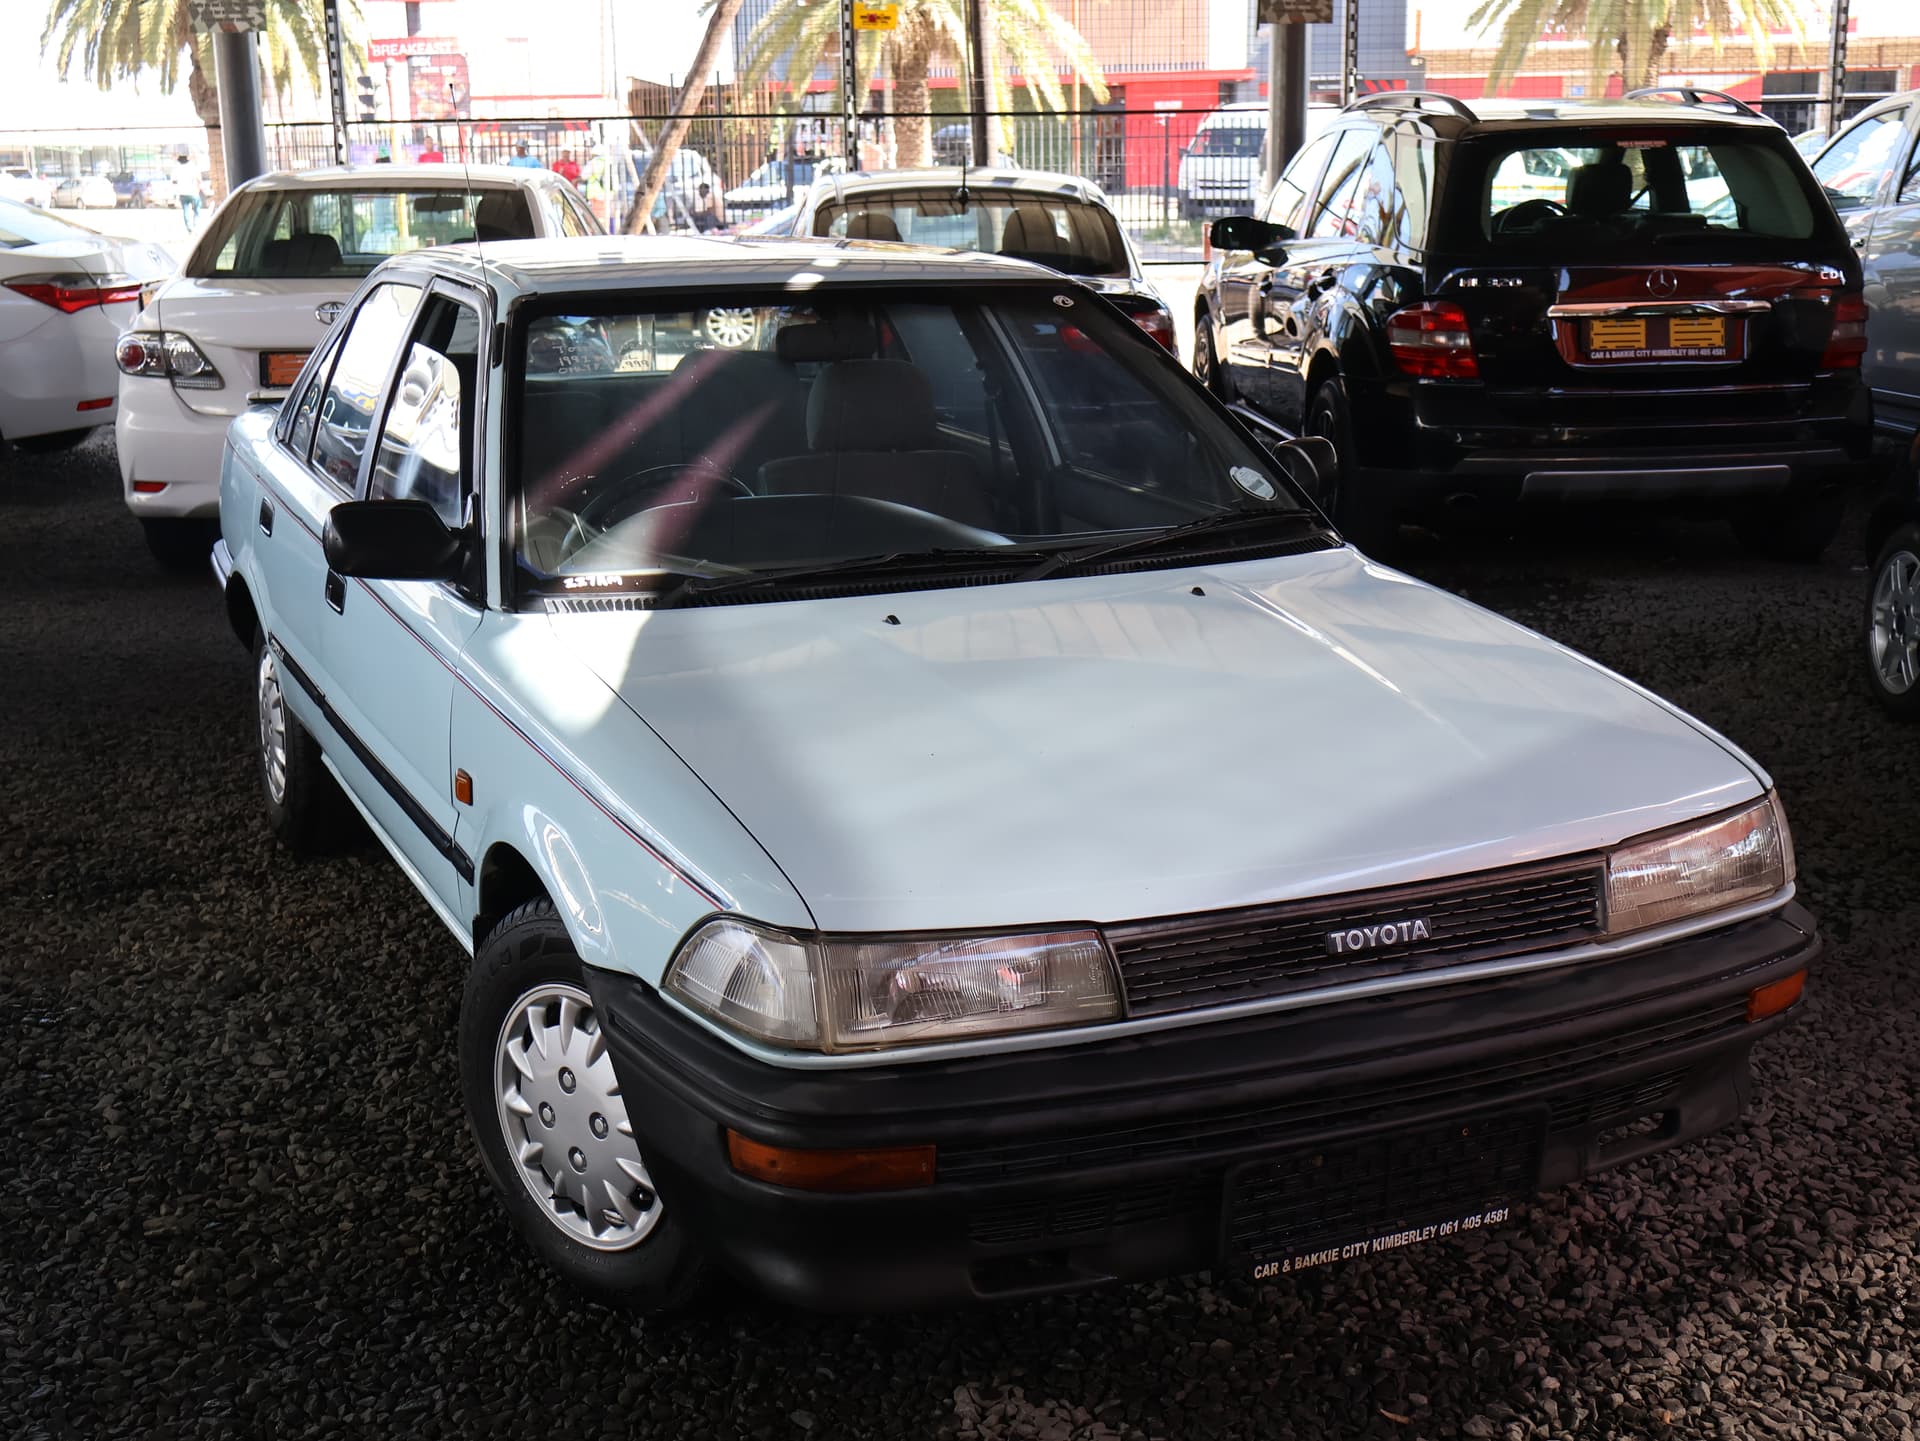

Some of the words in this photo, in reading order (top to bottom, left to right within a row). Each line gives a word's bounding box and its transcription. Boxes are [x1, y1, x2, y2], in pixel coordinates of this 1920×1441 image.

[372, 42, 453, 56] BREAKFAST
[1331, 919, 1430, 953] TOYOTA
[1254, 1262, 1279, 1279] CAR
[1282, 1261, 1291, 1273] &
[1295, 1248, 1340, 1270] BAKKIE
[1342, 1240, 1370, 1258] CITY
[1372, 1224, 1437, 1252] KIMBERLEY
[1439, 1219, 1459, 1236] 061
[1461, 1213, 1482, 1231] 405
[1483, 1207, 1510, 1225] 4581
